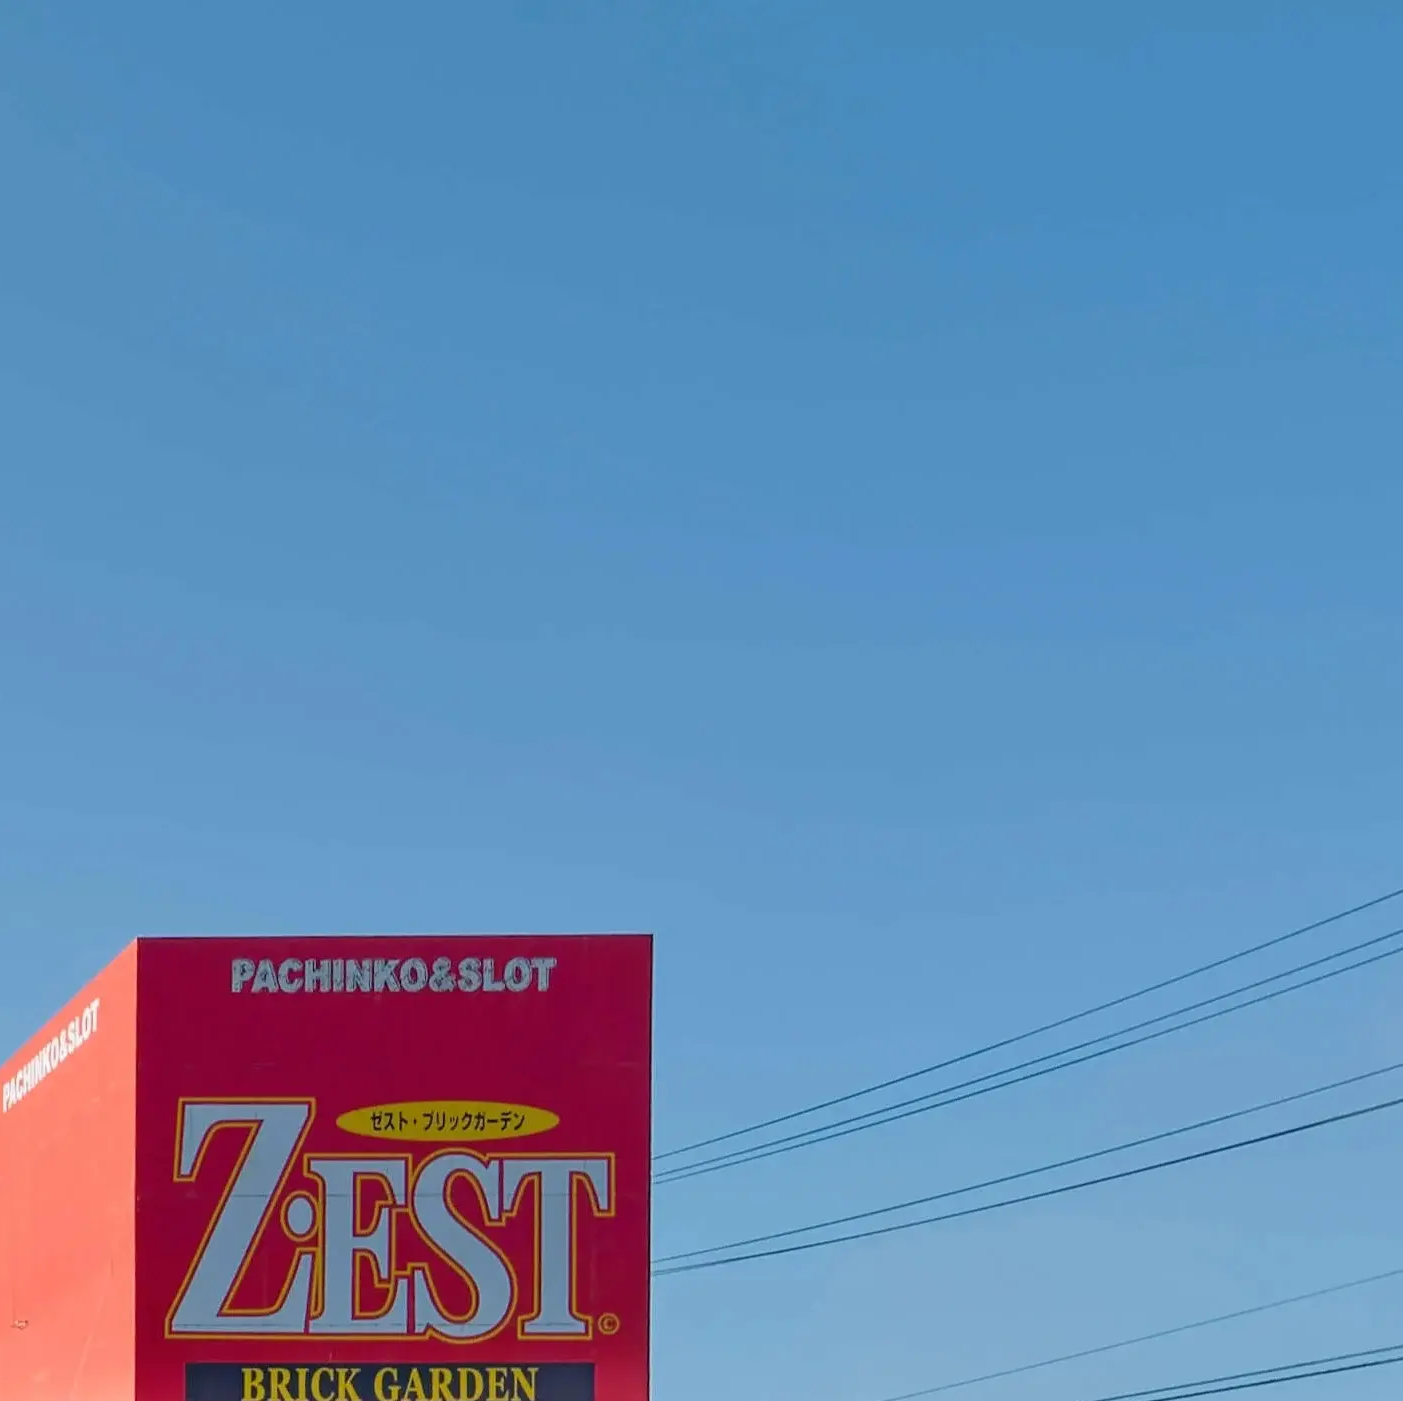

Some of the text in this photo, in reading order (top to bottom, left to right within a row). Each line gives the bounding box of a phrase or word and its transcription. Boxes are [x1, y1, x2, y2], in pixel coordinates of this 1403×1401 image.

[231, 957, 557, 993] PACHINKO&SLOT
[2, 998, 100, 1112] PACHINKO&SLOT
[371, 1111, 525, 1131] ゼスト・ブリックガーデン
